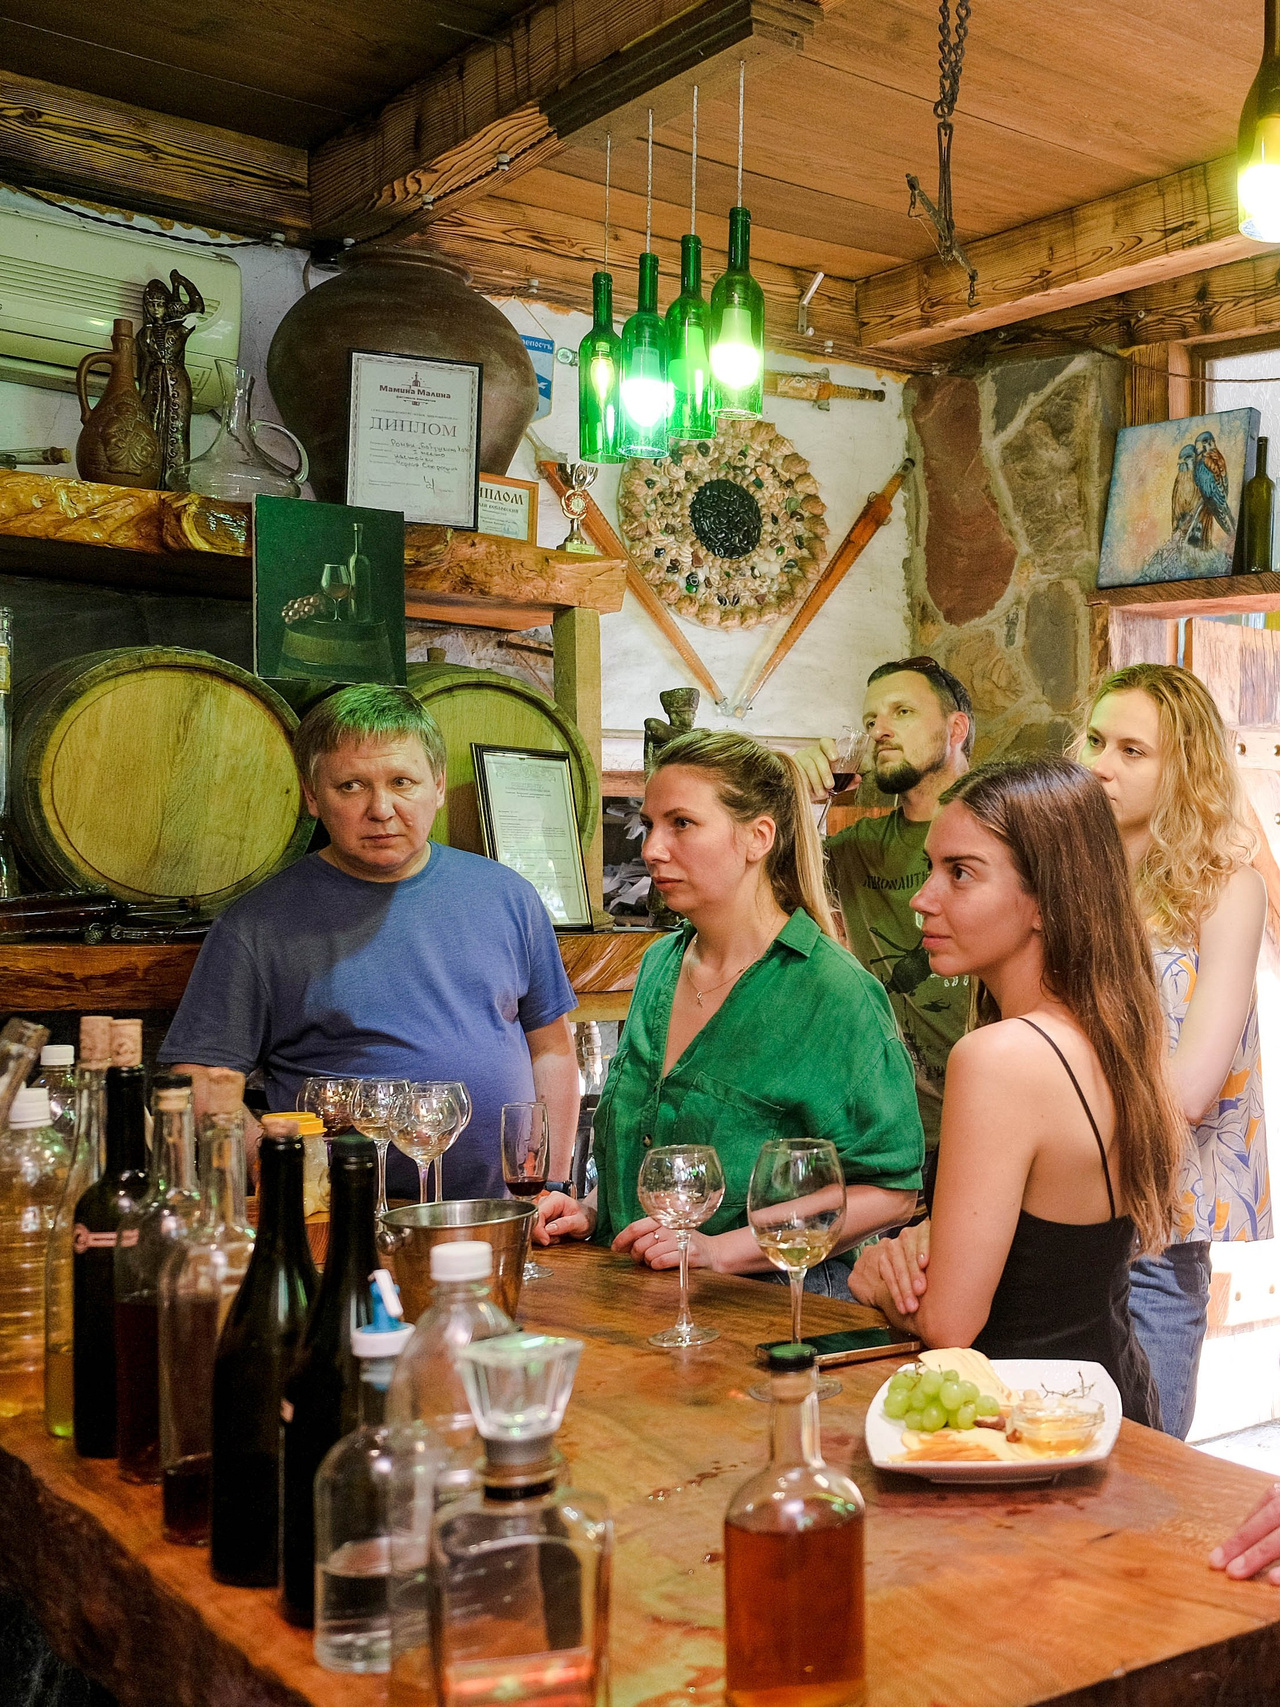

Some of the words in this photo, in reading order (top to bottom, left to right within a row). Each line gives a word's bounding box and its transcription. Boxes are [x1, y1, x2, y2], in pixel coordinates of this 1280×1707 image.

[379, 384, 416, 395] Мамина
[417, 388, 451, 399] Малина
[369, 416, 457, 438] ДИПЛОМ
[480, 487, 523, 506] ПЛОМ
